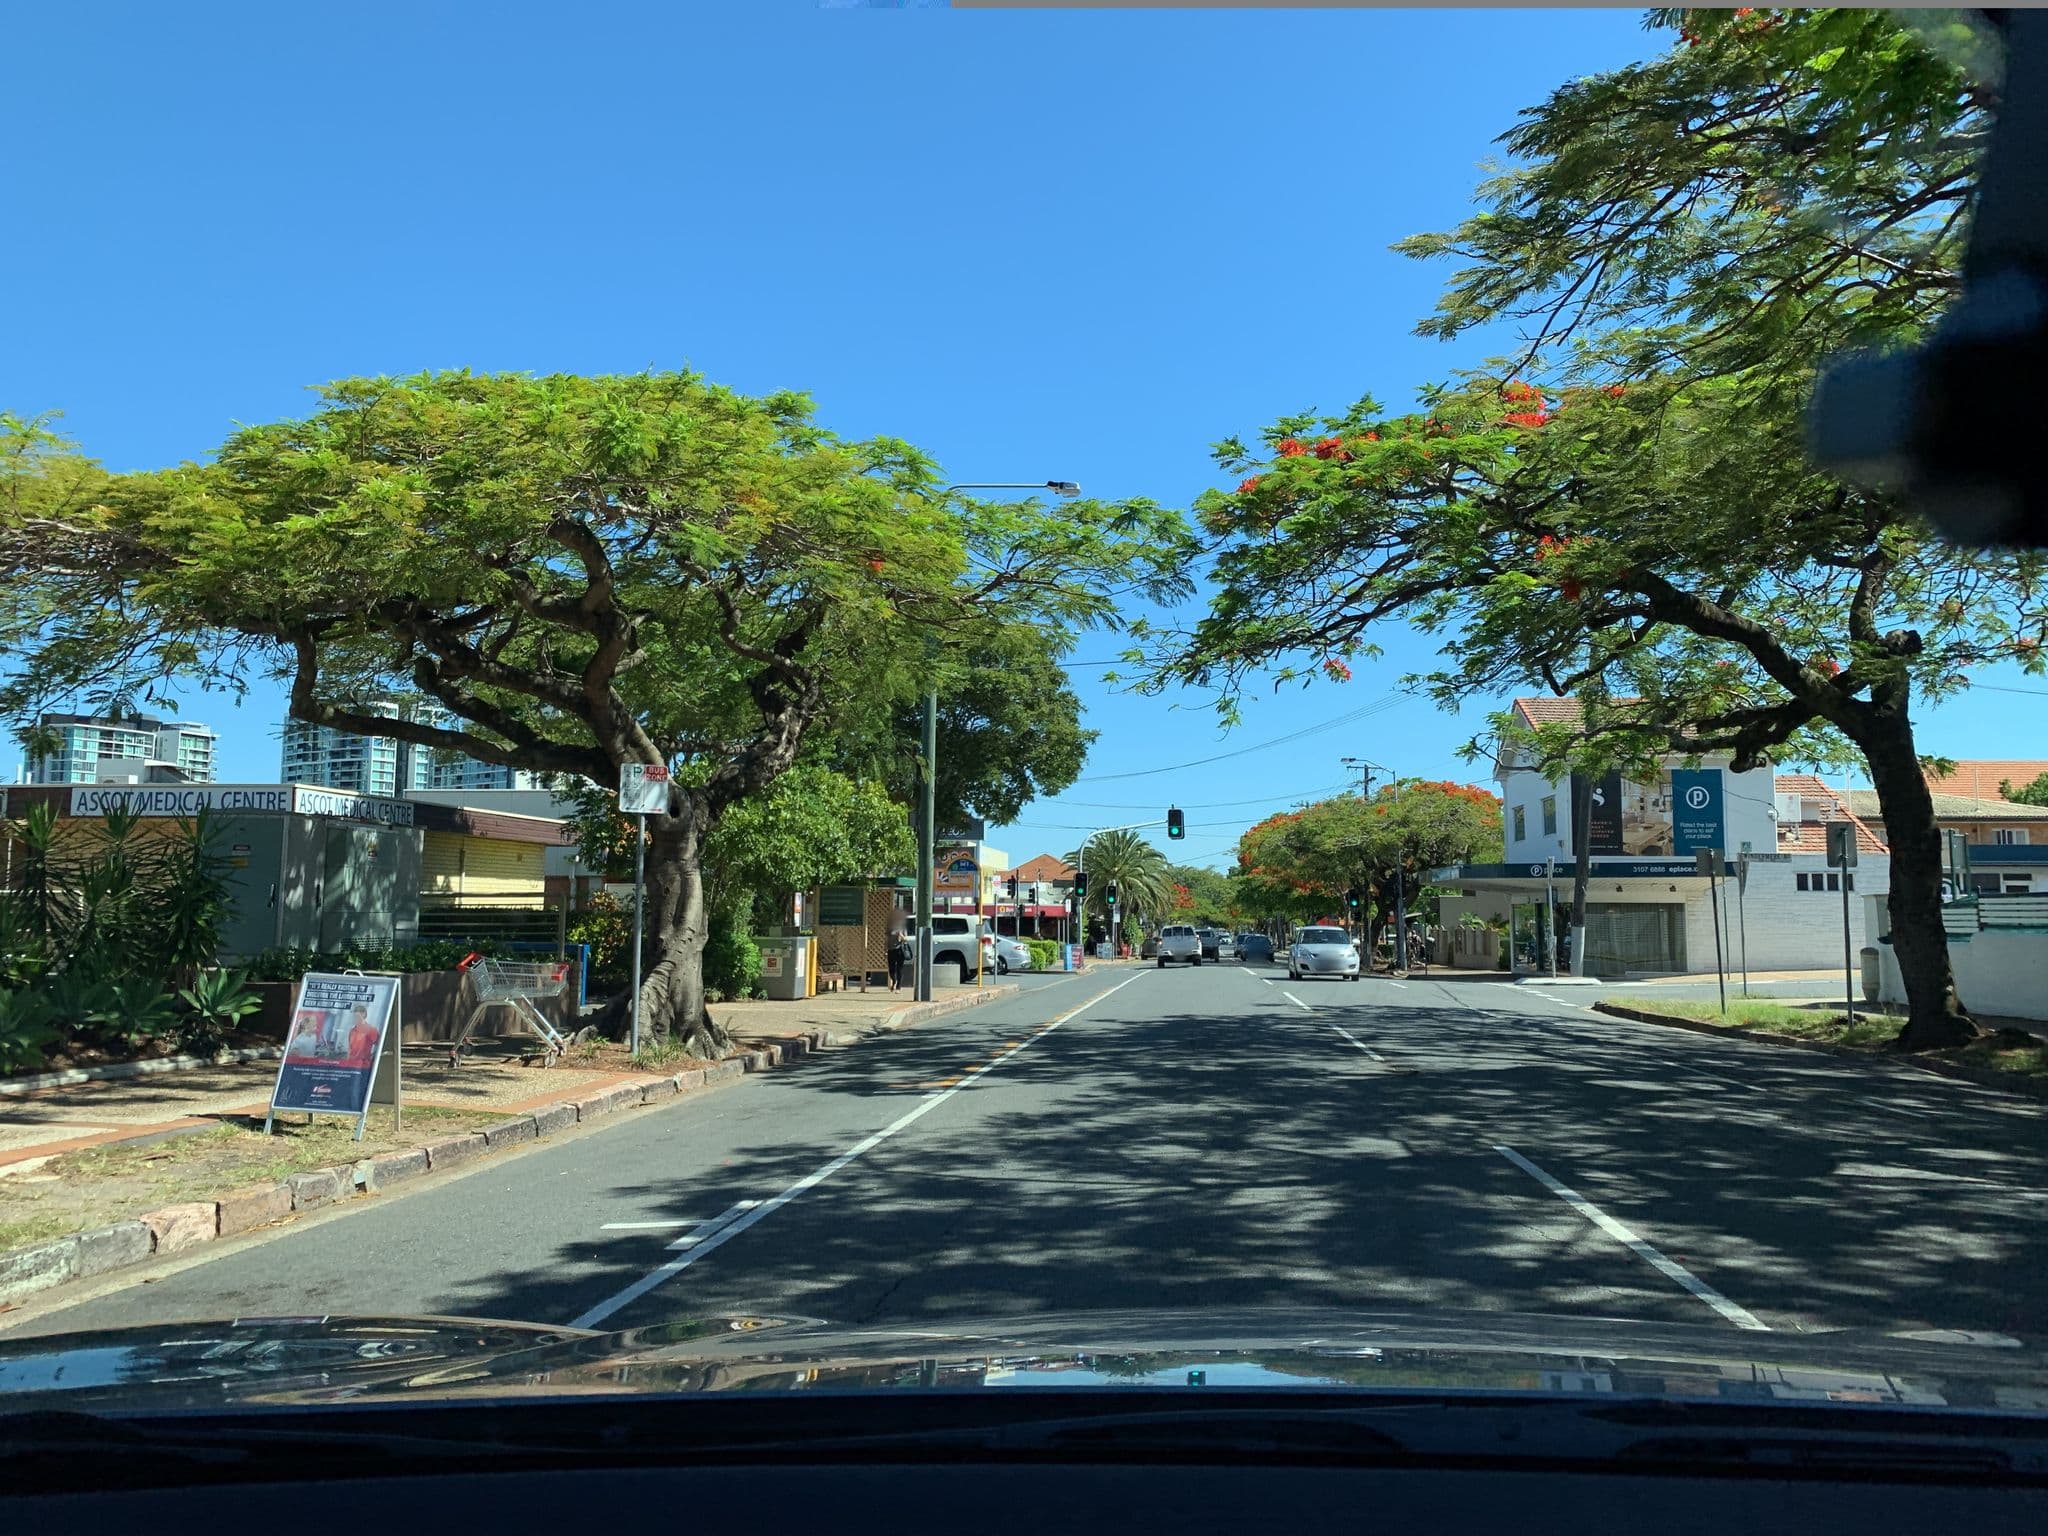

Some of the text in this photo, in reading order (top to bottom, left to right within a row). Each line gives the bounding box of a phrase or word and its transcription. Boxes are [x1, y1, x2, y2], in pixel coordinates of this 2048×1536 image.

[648, 766, 665, 774] BUS
[77, 791, 134, 812] ASCOT
[221, 791, 287, 811] CENTRE
[299, 792, 412, 824] ASCOT MEDICAL CENTRE
[1543, 866, 1564, 875] pce
[1668, 865, 1699, 874] eplace.c
